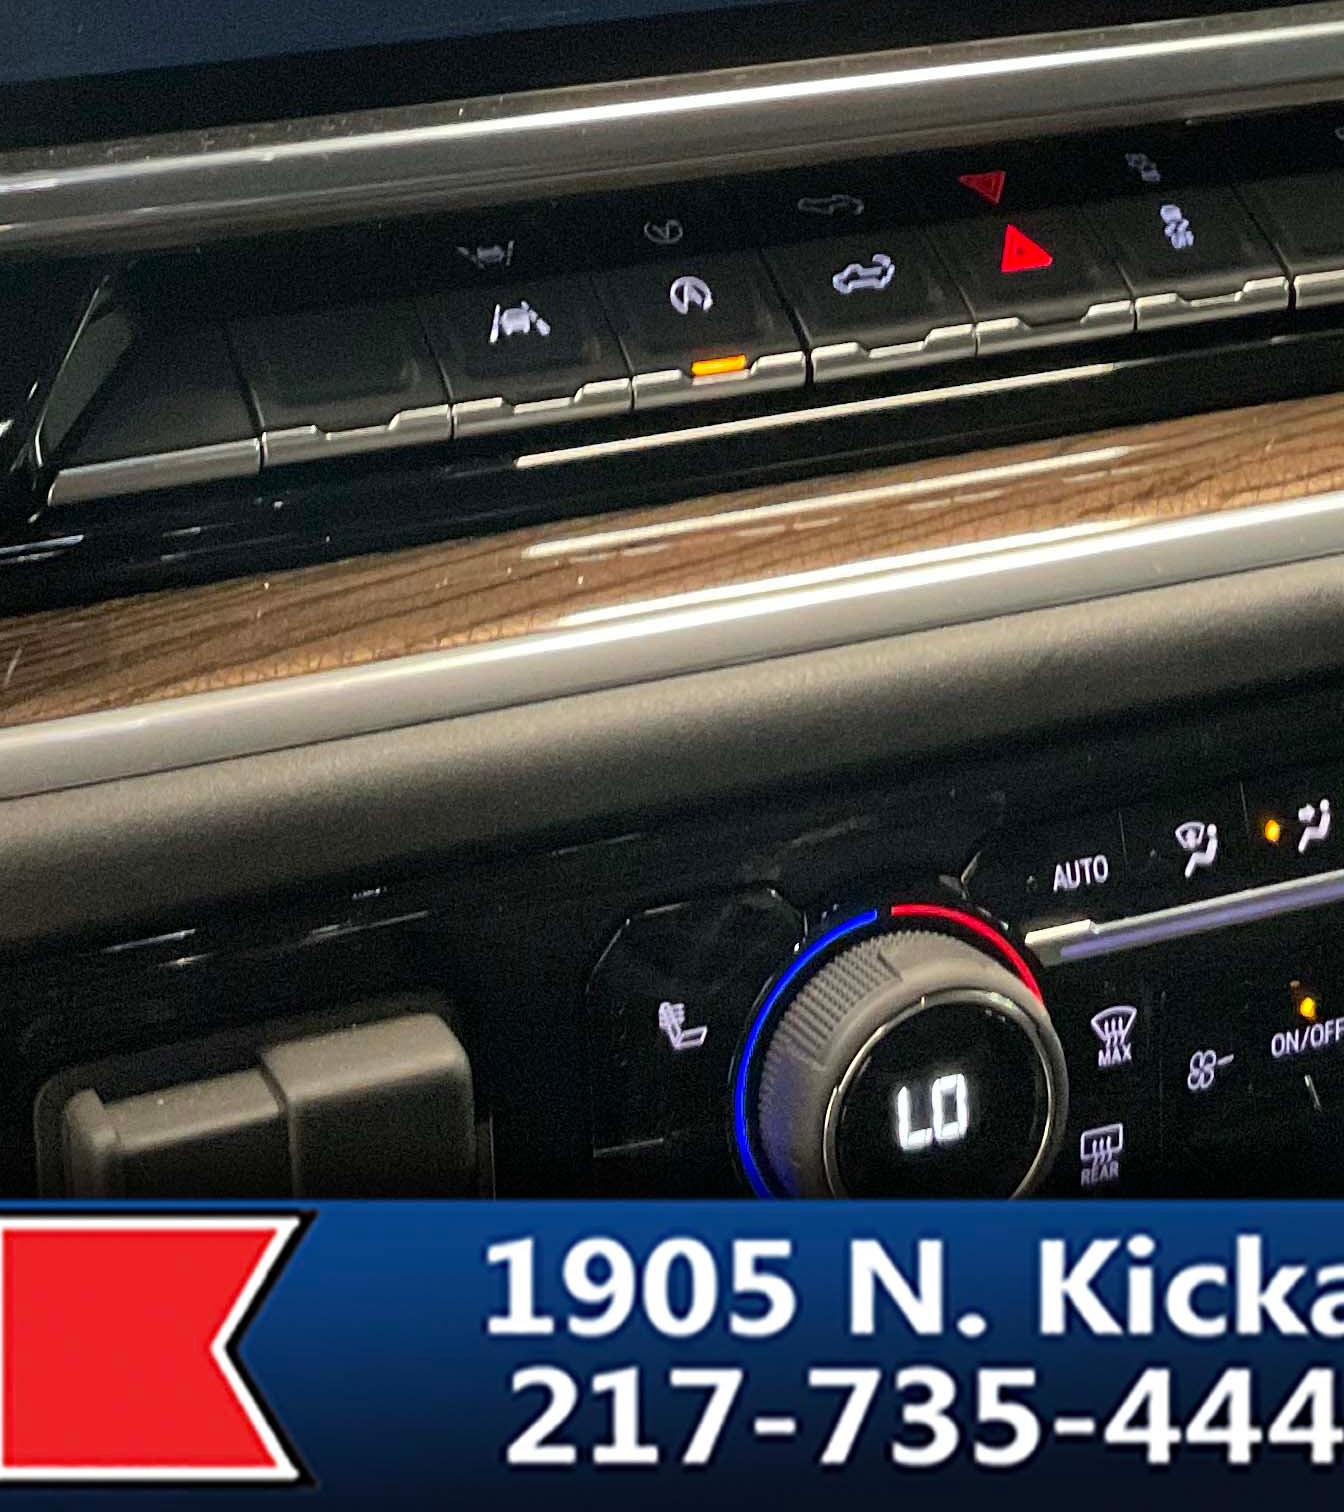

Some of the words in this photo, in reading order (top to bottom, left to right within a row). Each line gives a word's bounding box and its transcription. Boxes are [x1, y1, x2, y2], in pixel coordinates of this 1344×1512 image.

[1053, 855, 1109, 892] AUTO
[1097, 1042, 1133, 1068] MAX
[1080, 1160, 1120, 1187] REAR
